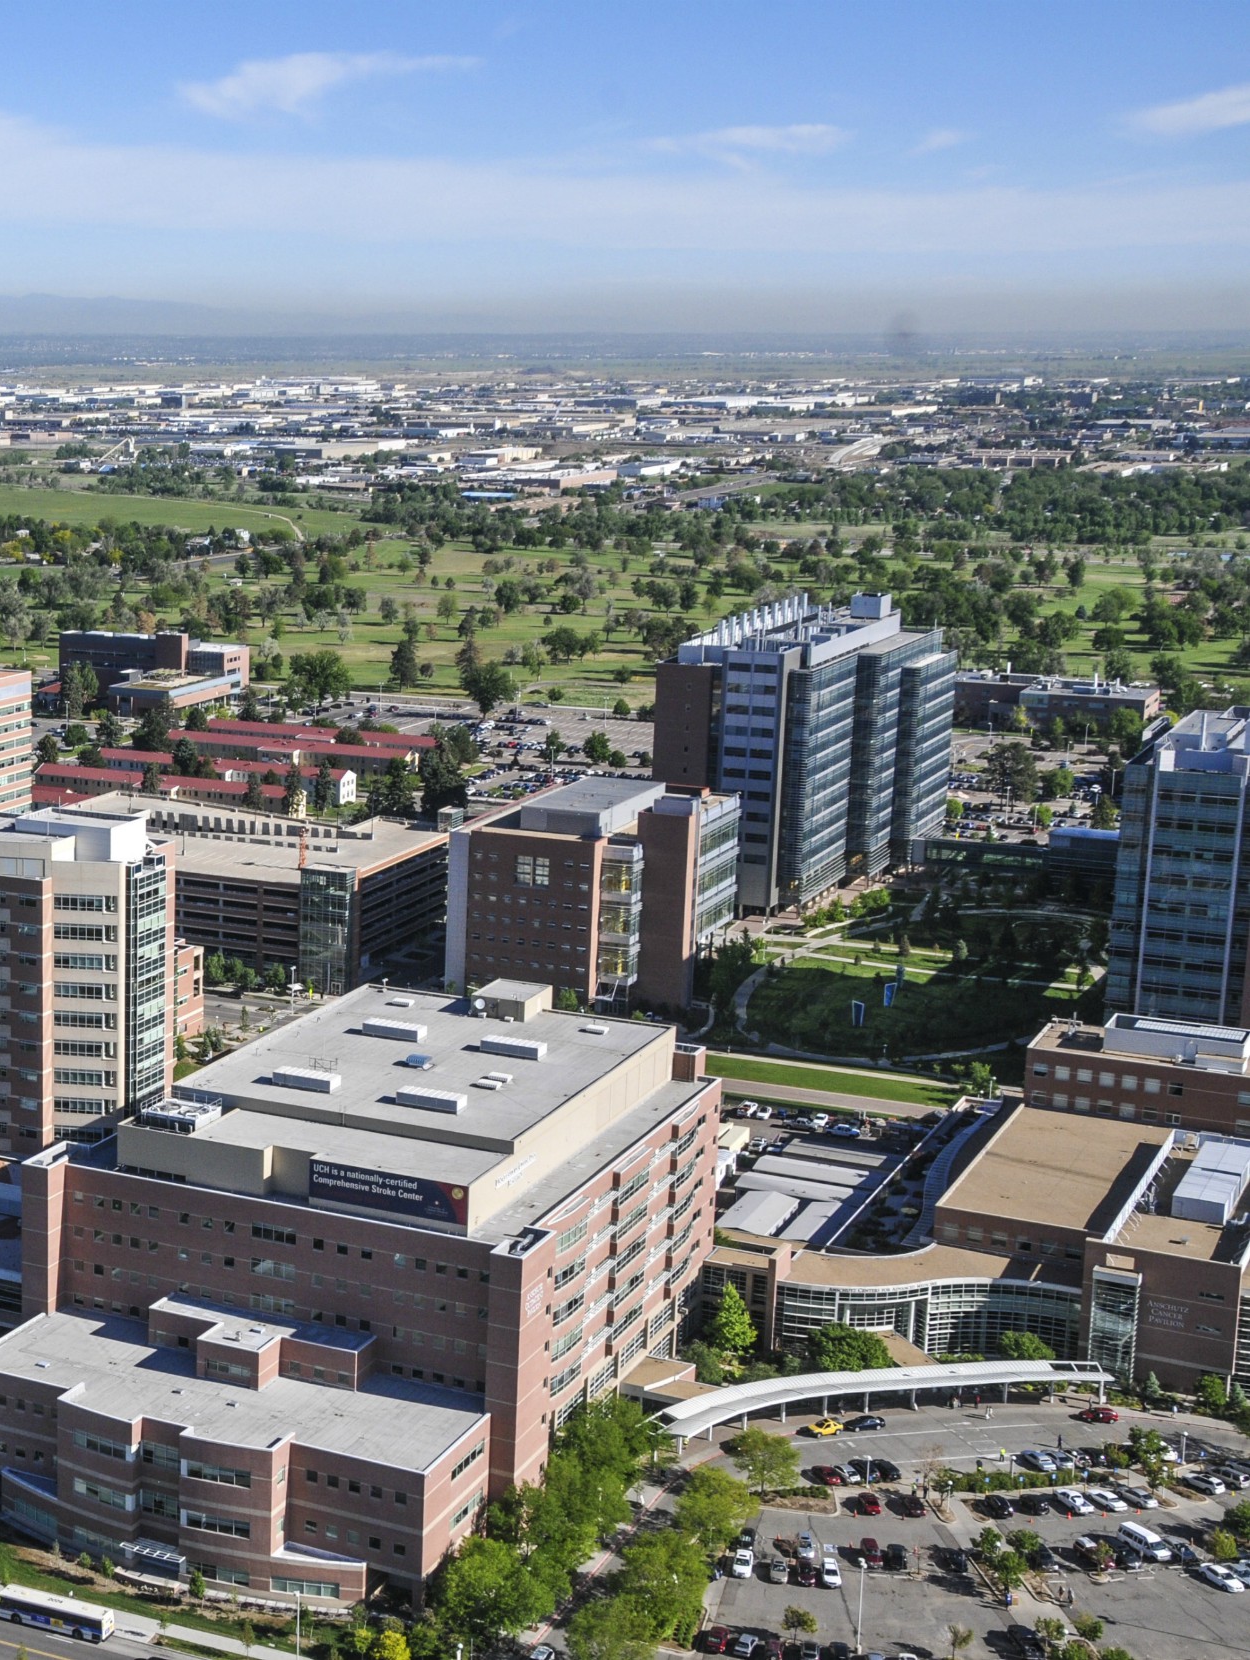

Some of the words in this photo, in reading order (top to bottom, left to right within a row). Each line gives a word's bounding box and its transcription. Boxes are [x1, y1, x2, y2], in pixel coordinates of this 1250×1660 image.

[313, 1163, 330, 1174] UCH
[331, 1166, 338, 1175] is
[346, 1171, 417, 1190] nationally-certified
[313, 1174, 369, 1191] Comprehensive
[371, 1184, 396, 1197] Stroke
[398, 1189, 423, 1201] Center
[1147, 1299, 1189, 1313] ANSCHUTZ
[1151, 1308, 1183, 1320] CANCER
[1148, 1315, 1184, 1328] PAVILION
